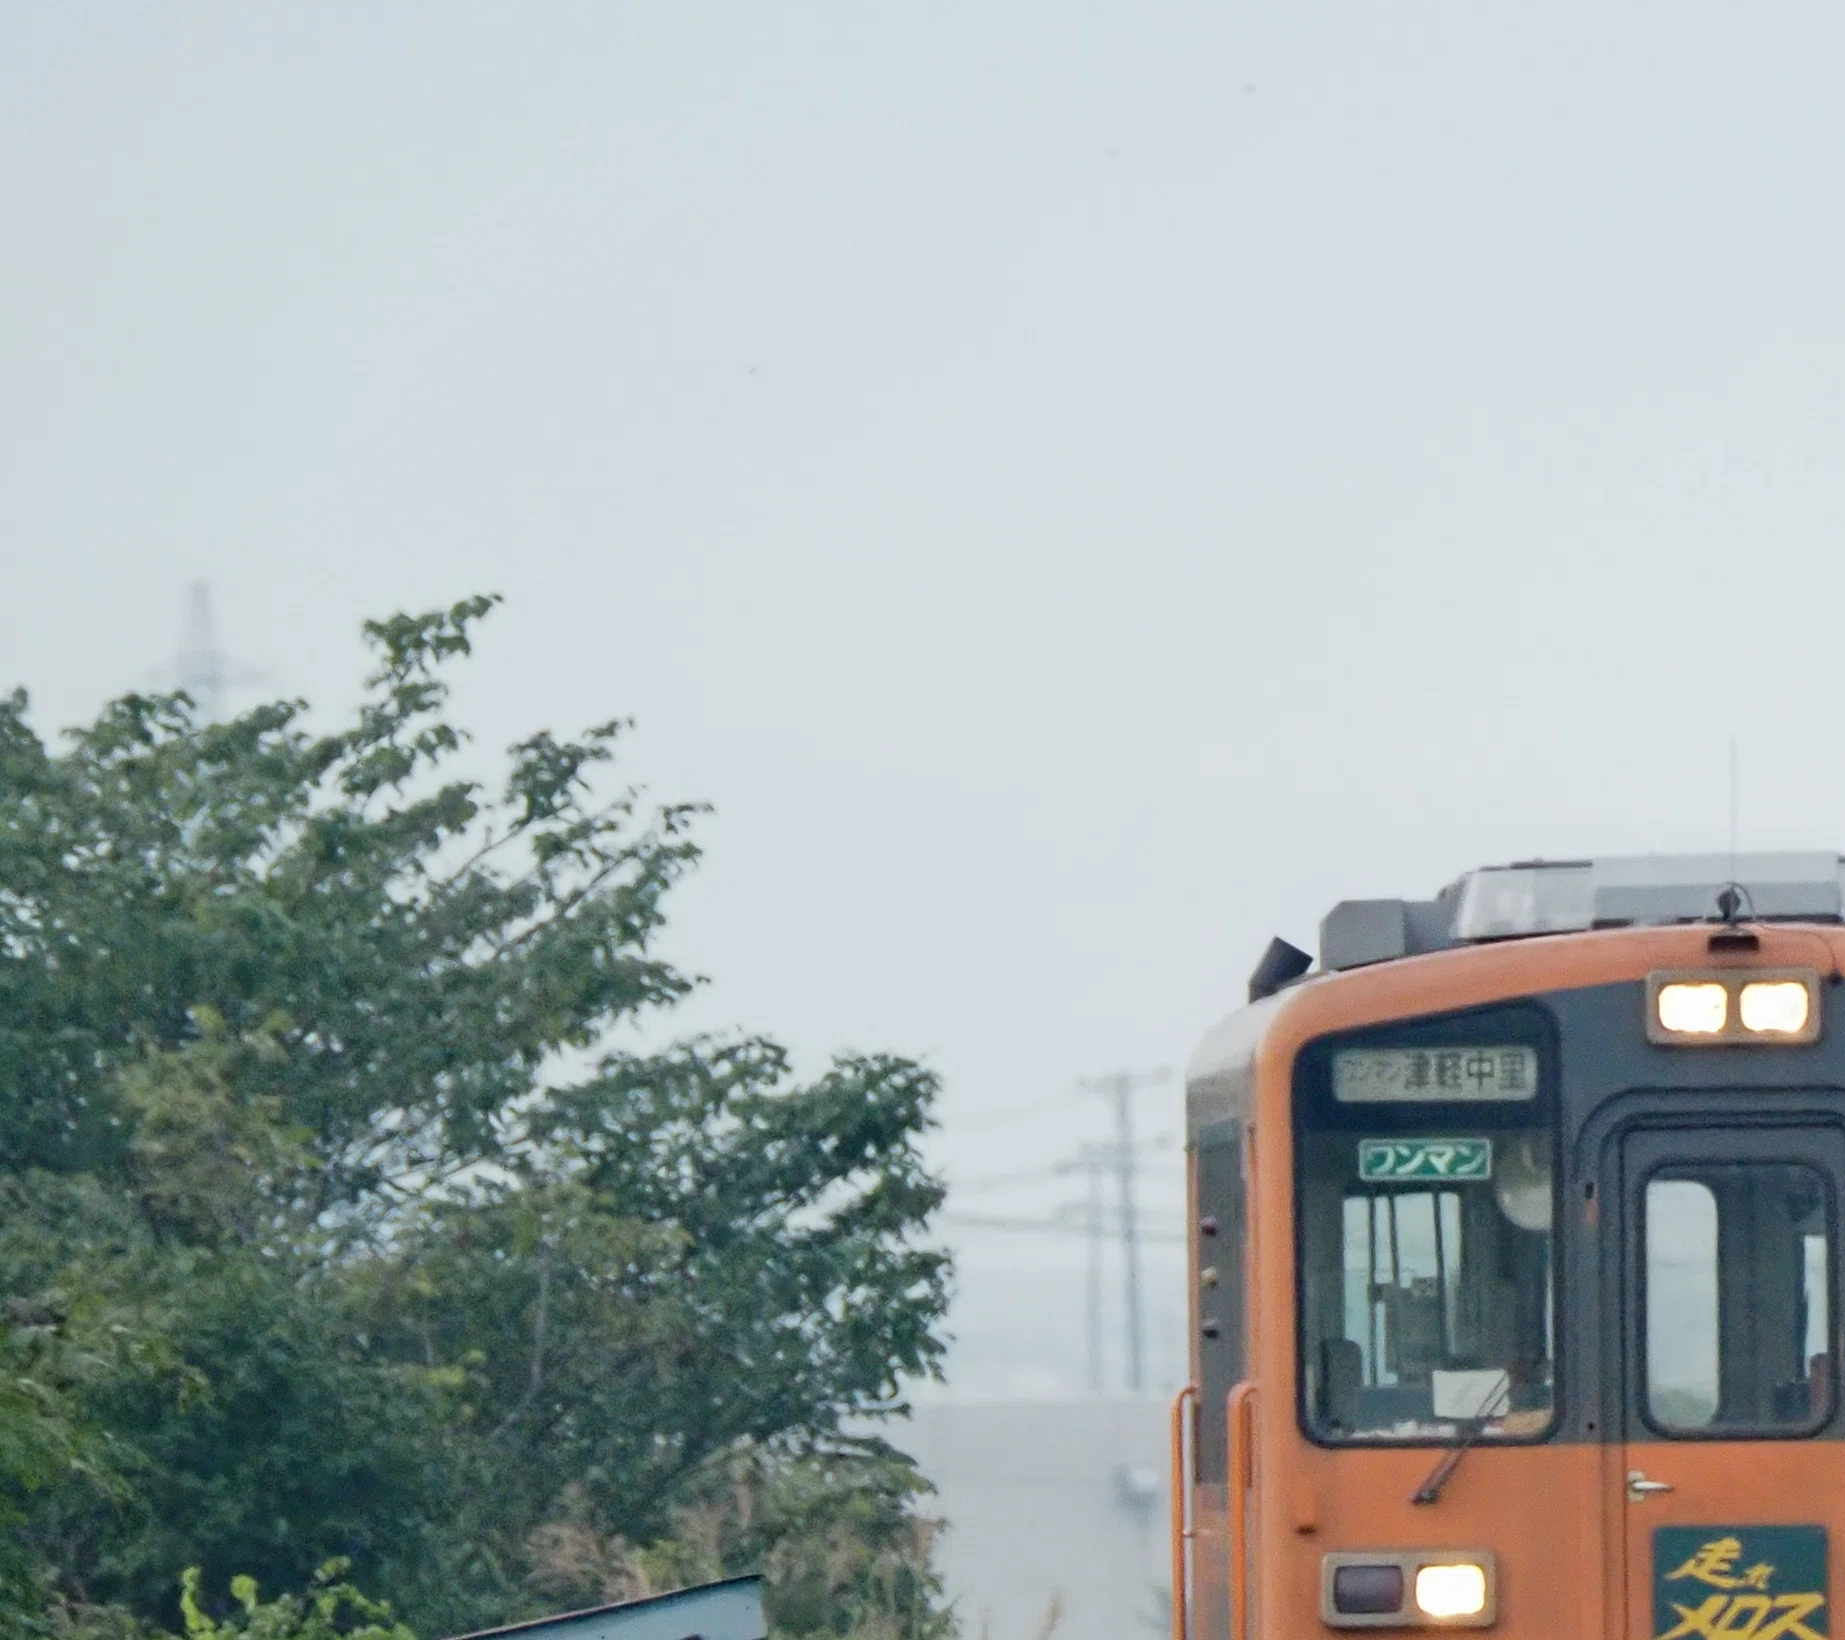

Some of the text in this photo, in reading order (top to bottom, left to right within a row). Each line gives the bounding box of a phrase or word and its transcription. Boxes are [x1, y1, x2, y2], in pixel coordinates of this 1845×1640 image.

[1367, 1144, 1486, 1176] ワンマン
[1665, 1536, 1775, 1590] 走れ
